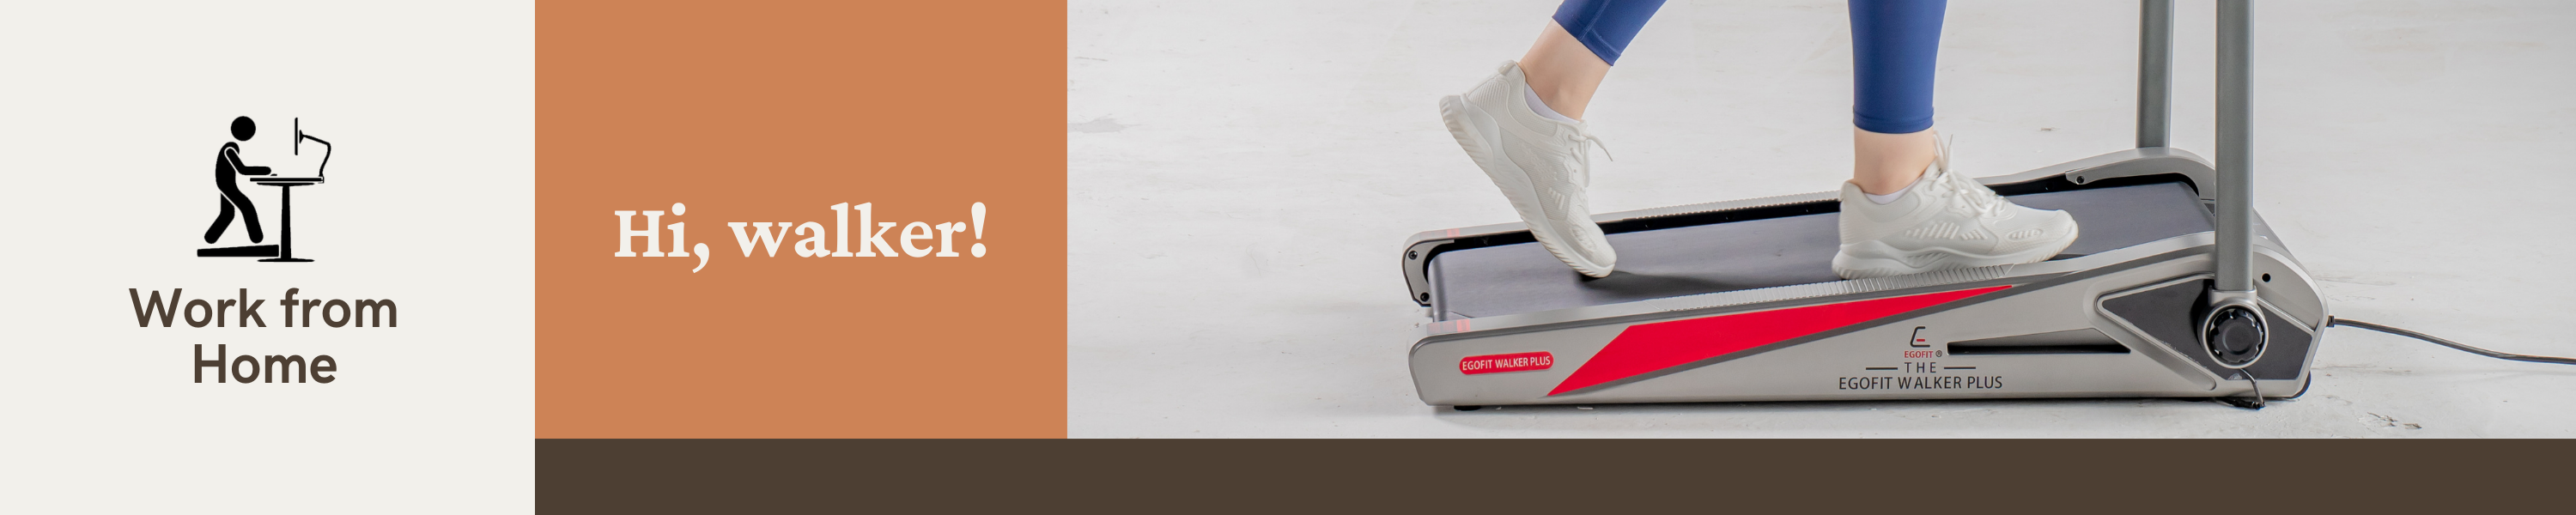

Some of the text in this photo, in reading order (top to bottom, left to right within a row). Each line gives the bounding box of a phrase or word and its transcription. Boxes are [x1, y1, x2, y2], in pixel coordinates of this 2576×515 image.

[1904, 350, 1934, 359] EGOFIT
[1461, 355, 1551, 371] EGOFIT WALKER PLUS
[1904, 361, 1937, 373] THE
[1838, 375, 2003, 391] EGOFIT WALKER PLUS
